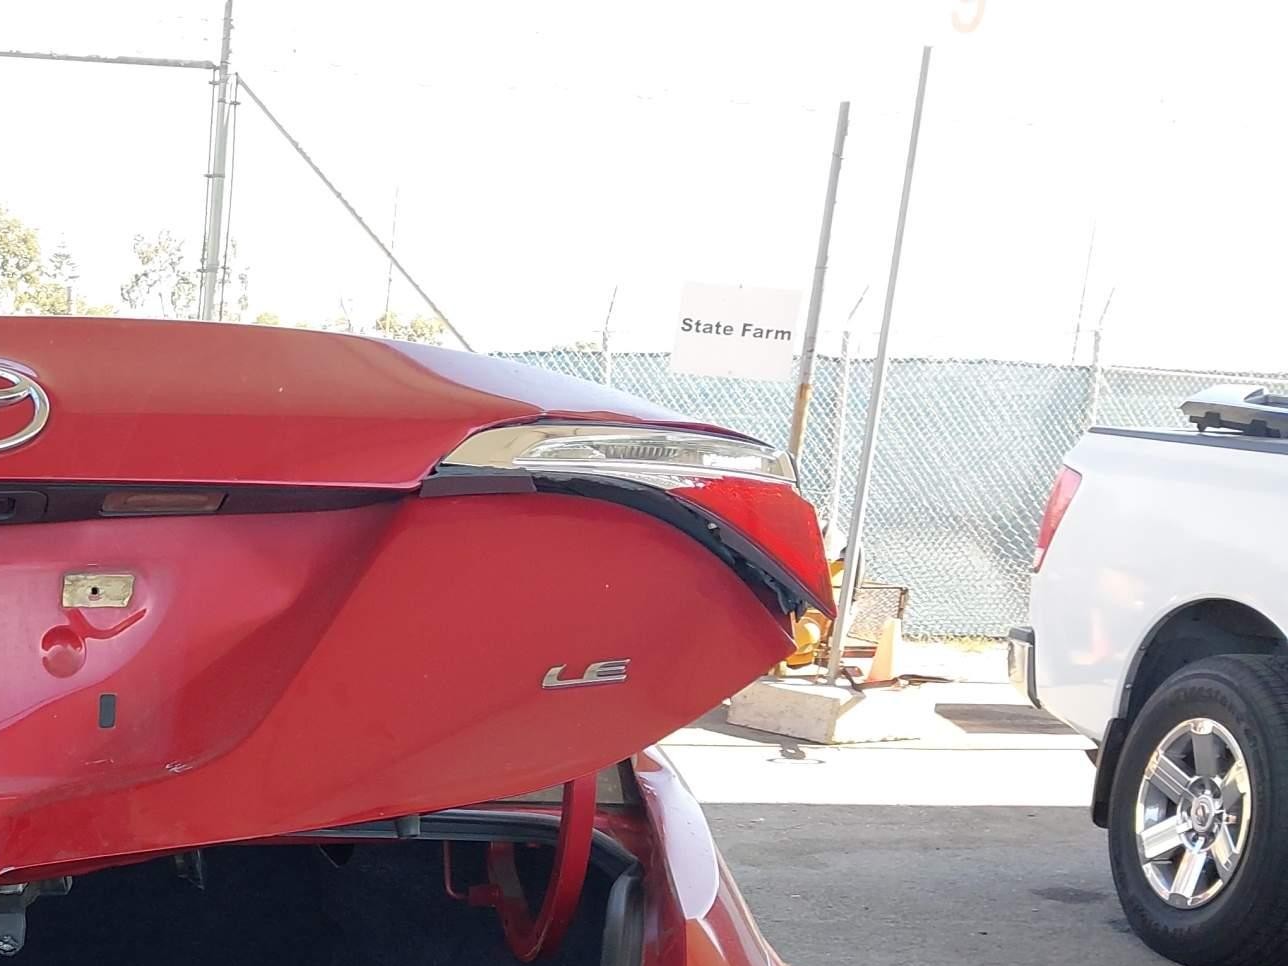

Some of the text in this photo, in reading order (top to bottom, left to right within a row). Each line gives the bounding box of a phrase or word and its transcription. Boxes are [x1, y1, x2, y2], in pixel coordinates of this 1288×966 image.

[681, 317, 792, 341] State Farm
[541, 658, 632, 690] LE
